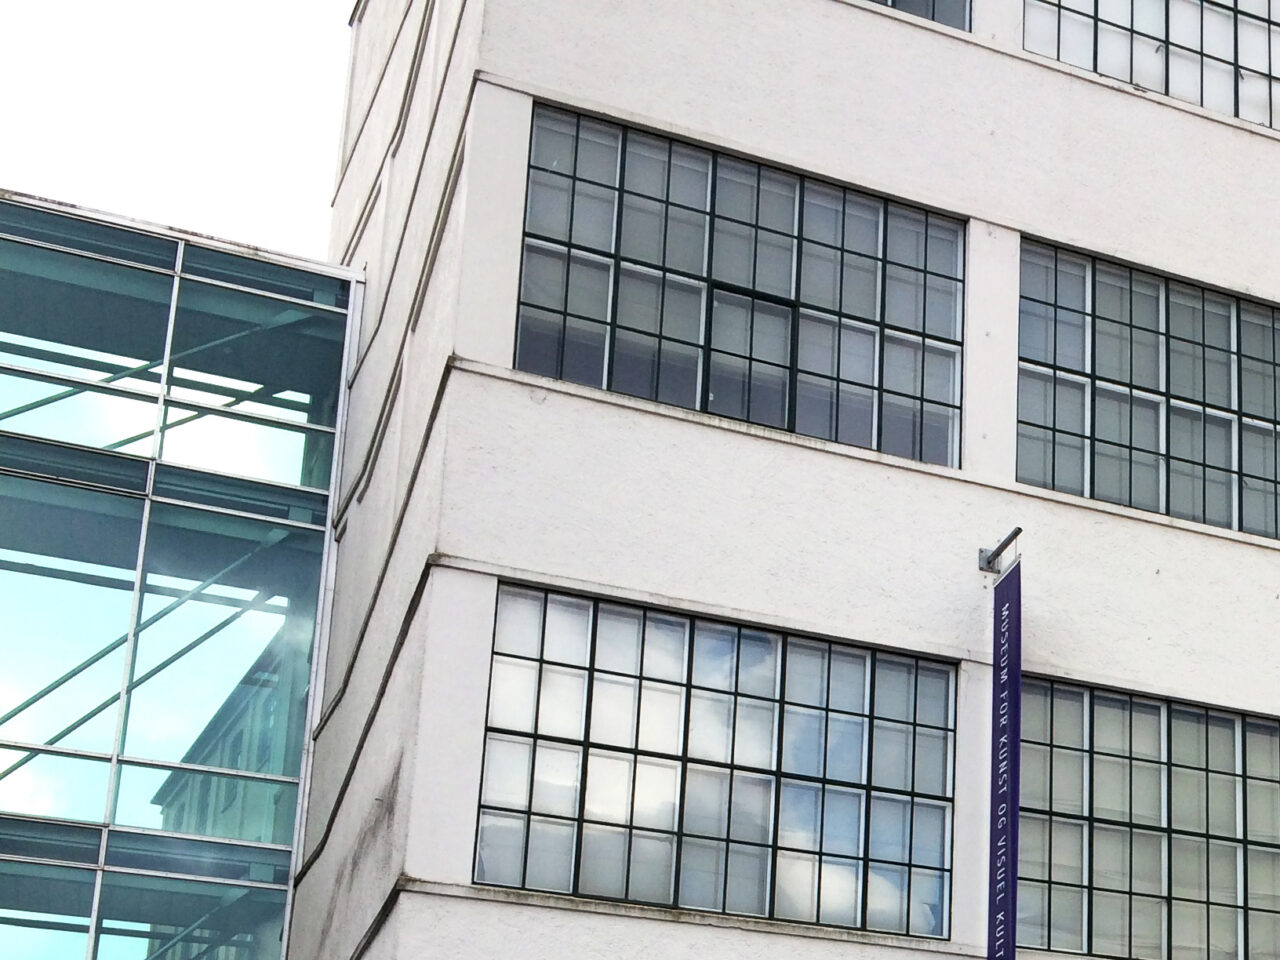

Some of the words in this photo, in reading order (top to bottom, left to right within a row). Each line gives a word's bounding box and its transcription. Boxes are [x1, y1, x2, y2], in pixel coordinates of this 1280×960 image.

[1000, 603, 1010, 683] MUSEUM
[1000, 691, 1009, 728] FOR
[998, 734, 1009, 794] KUNST
[997, 803, 1006, 829] OG
[996, 834, 1006, 905] VISUEL
